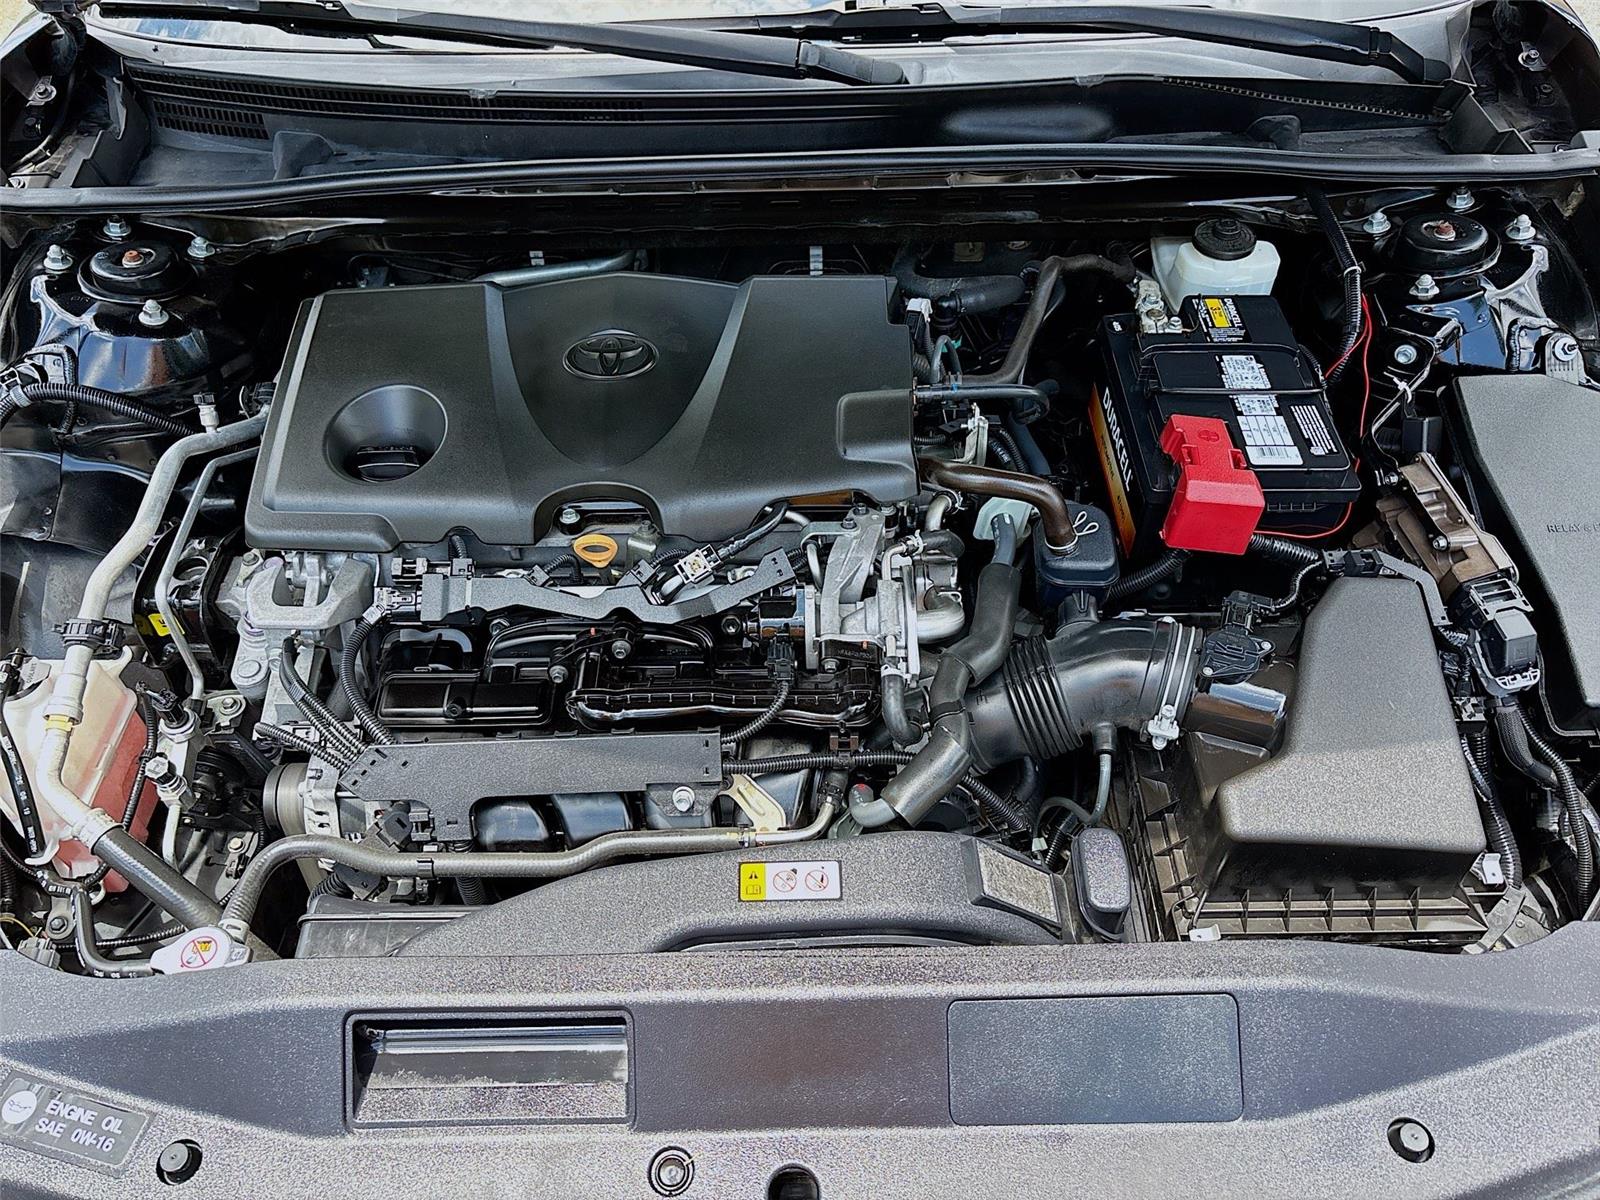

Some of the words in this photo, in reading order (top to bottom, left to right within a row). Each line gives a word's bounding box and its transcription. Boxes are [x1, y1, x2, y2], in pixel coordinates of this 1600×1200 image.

[1223, 298, 1243, 328] DURACELL
[1102, 386, 1132, 492] DURACELL
[1546, 523, 1581, 533] RELAY
[34, 1117, 67, 1138] SAE
[70, 1128, 115, 1153] 0W-16
[45, 1100, 98, 1126] ENGINE
[101, 1116, 123, 1135] OIL
